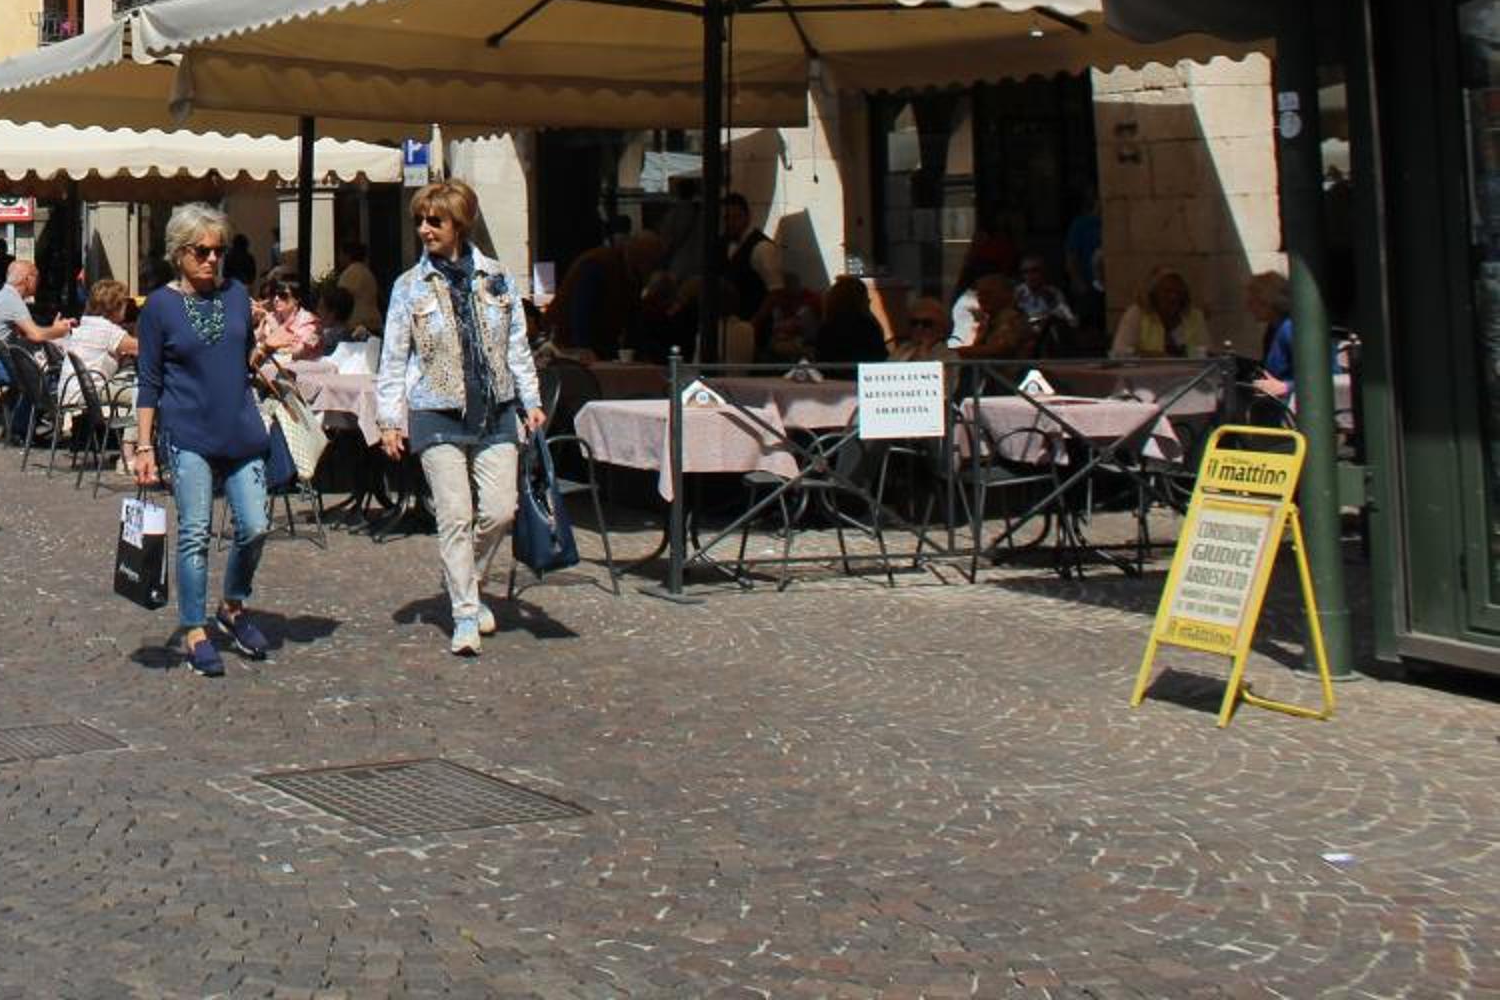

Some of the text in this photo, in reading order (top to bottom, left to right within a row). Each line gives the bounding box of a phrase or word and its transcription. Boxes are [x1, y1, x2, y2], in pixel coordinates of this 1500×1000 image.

[1207, 459, 1219, 478] il
[1219, 463, 1287, 485] mattino
[1197, 520, 1263, 545] CORIONE
[1191, 543, 1253, 568] GIUDICE
